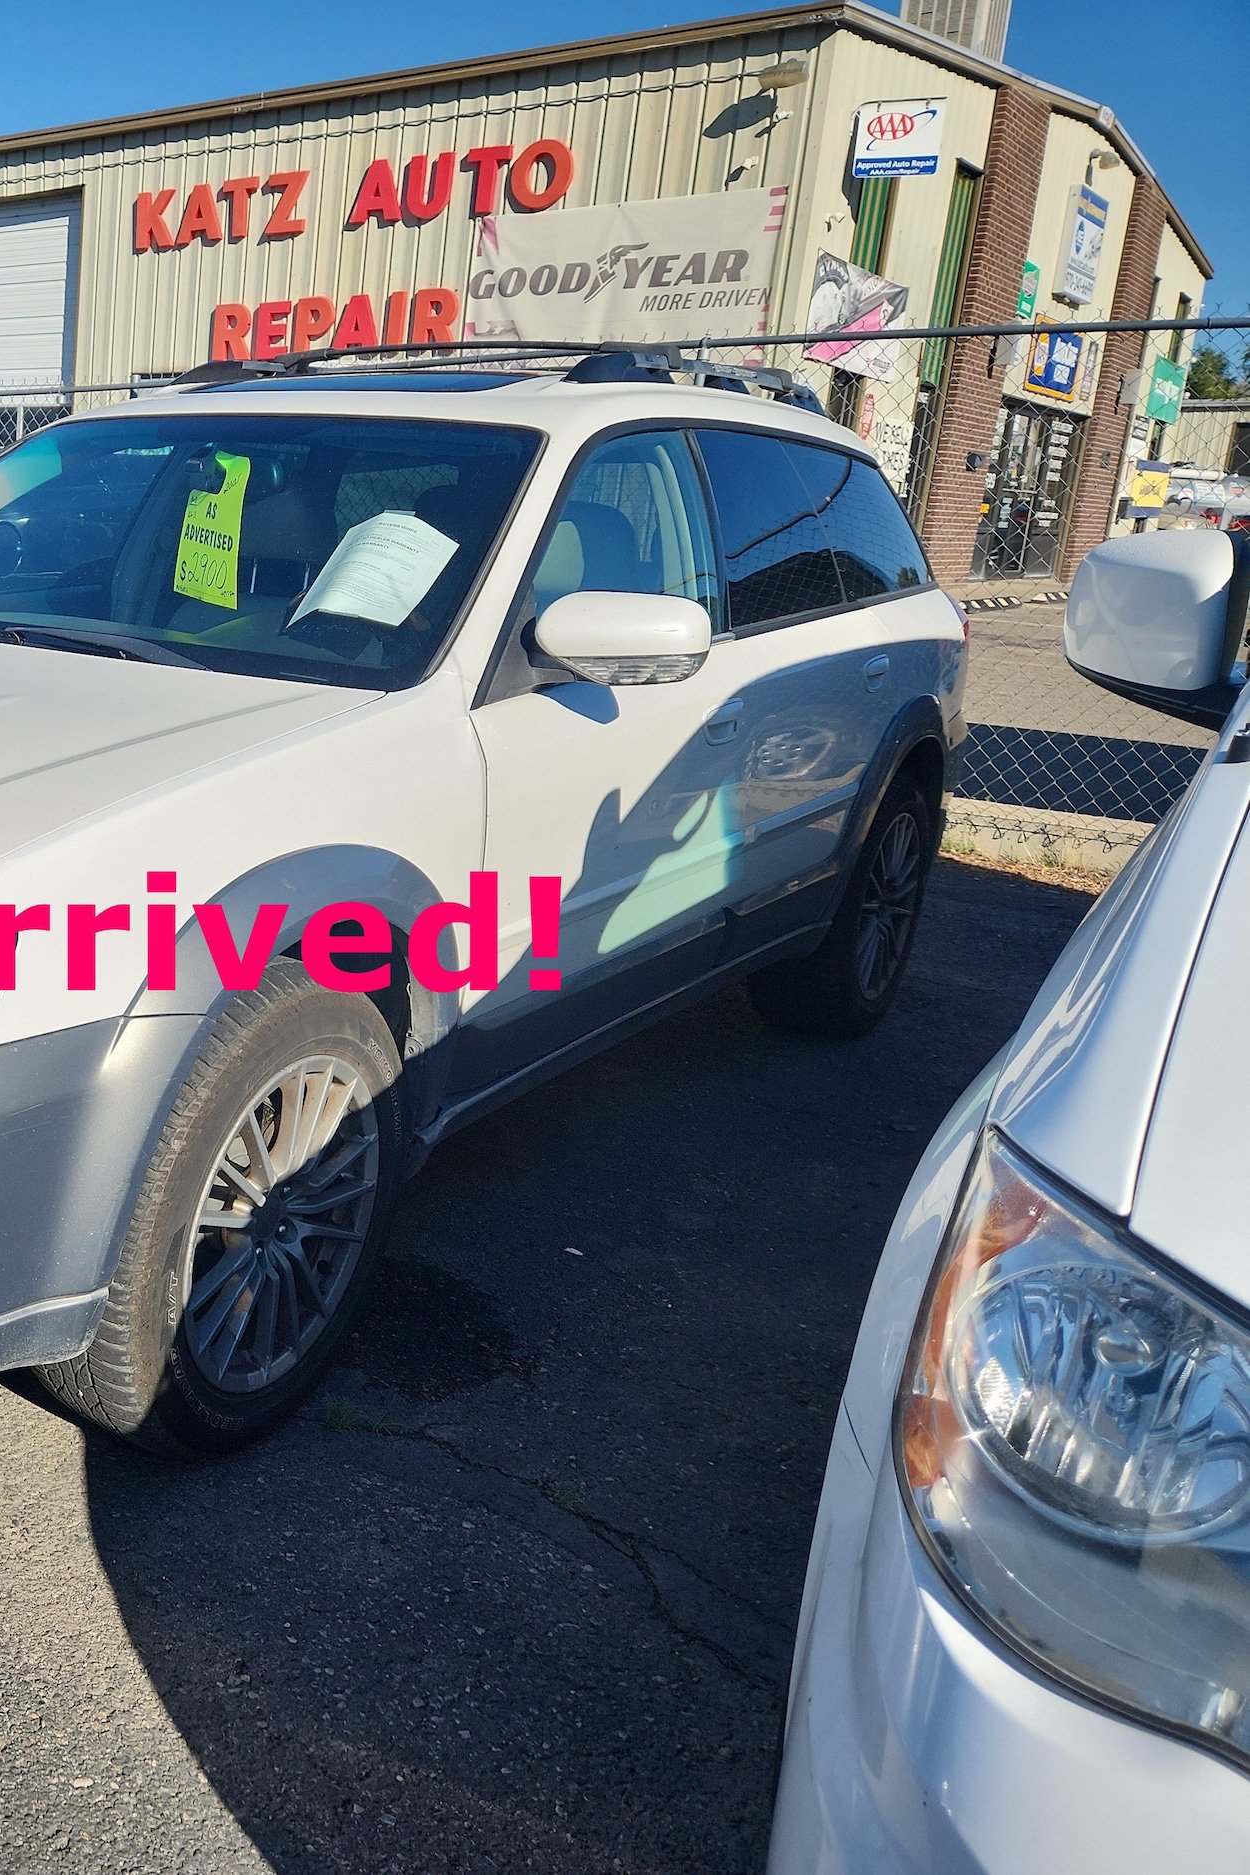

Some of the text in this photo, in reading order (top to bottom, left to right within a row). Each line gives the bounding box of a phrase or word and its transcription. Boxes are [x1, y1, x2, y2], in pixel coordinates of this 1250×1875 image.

[868, 112, 913, 140] AAA
[856, 159, 936, 170] Approved Auto Repair
[133, 138, 575, 255] KATZ AUTO
[639, 286, 772, 312] MORE DRIVEN
[212, 287, 460, 362] REPAIR
[205, 501, 217, 520] AS
[184, 523, 233, 552] ADVERTISED
